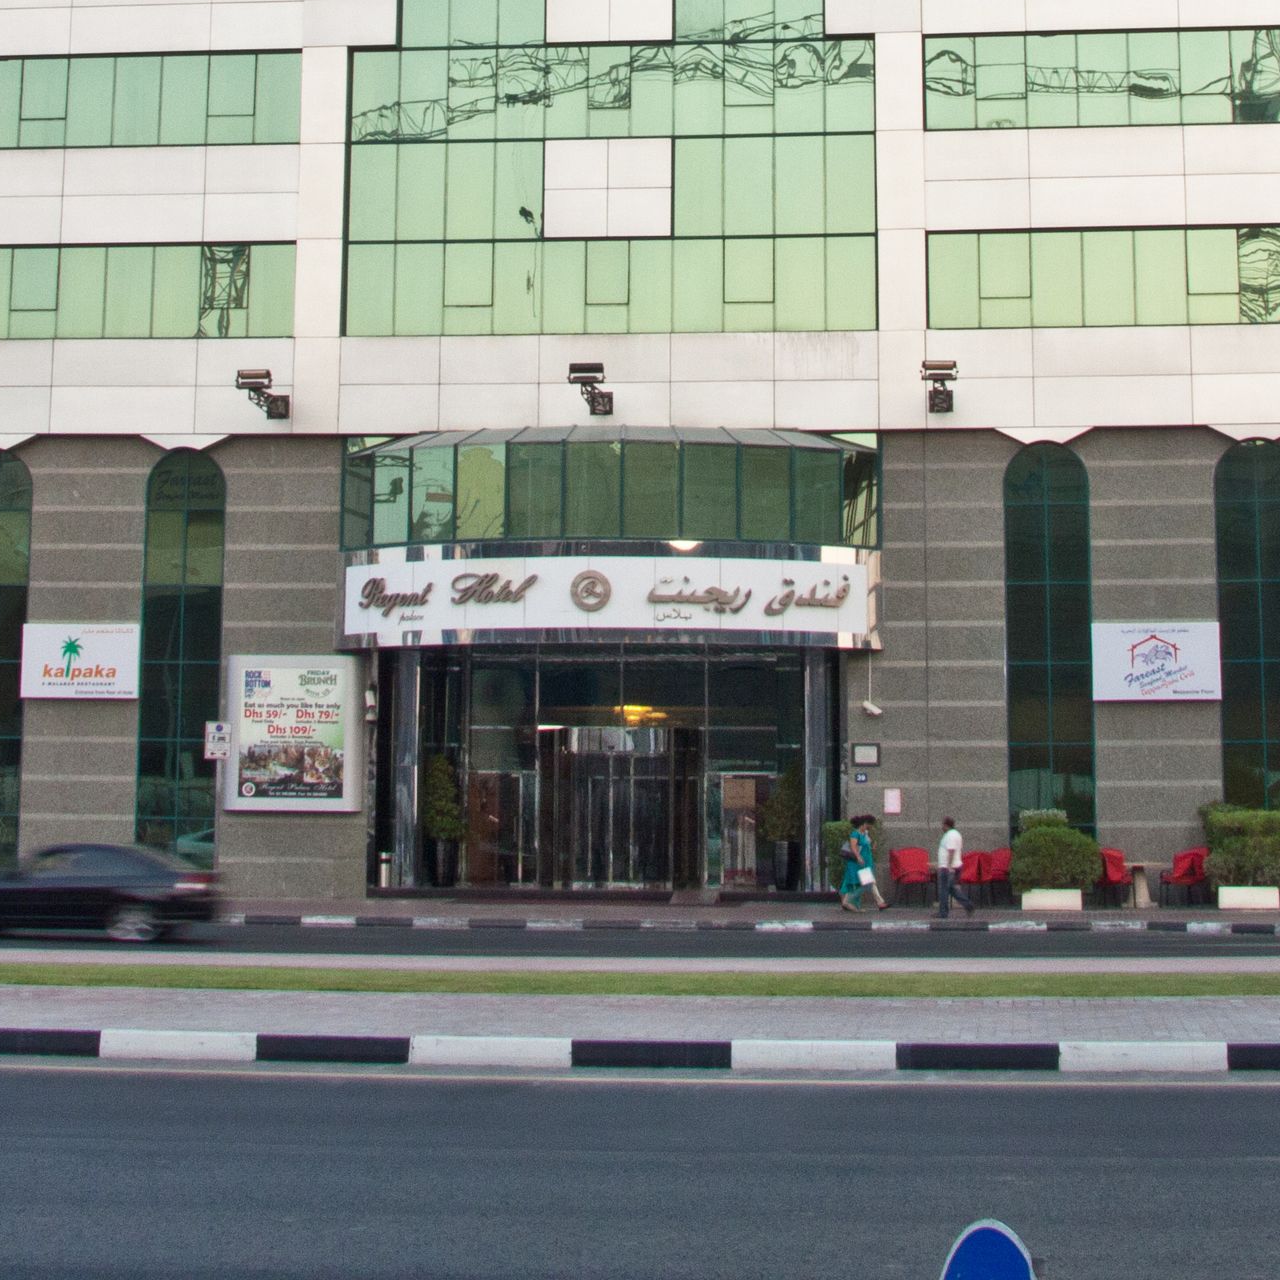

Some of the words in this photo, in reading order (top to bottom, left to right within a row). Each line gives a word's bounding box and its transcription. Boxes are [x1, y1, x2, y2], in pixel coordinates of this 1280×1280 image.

[358, 577, 434, 617] Regent
[451, 573, 539, 605] Hotel
[647, 576, 752, 613] ريجنت
[764, 574, 850, 617] فندق
[244, 709, 263, 718] Dhs
[296, 709, 315, 718] Dhs
[267, 725, 286, 734] Dhs
